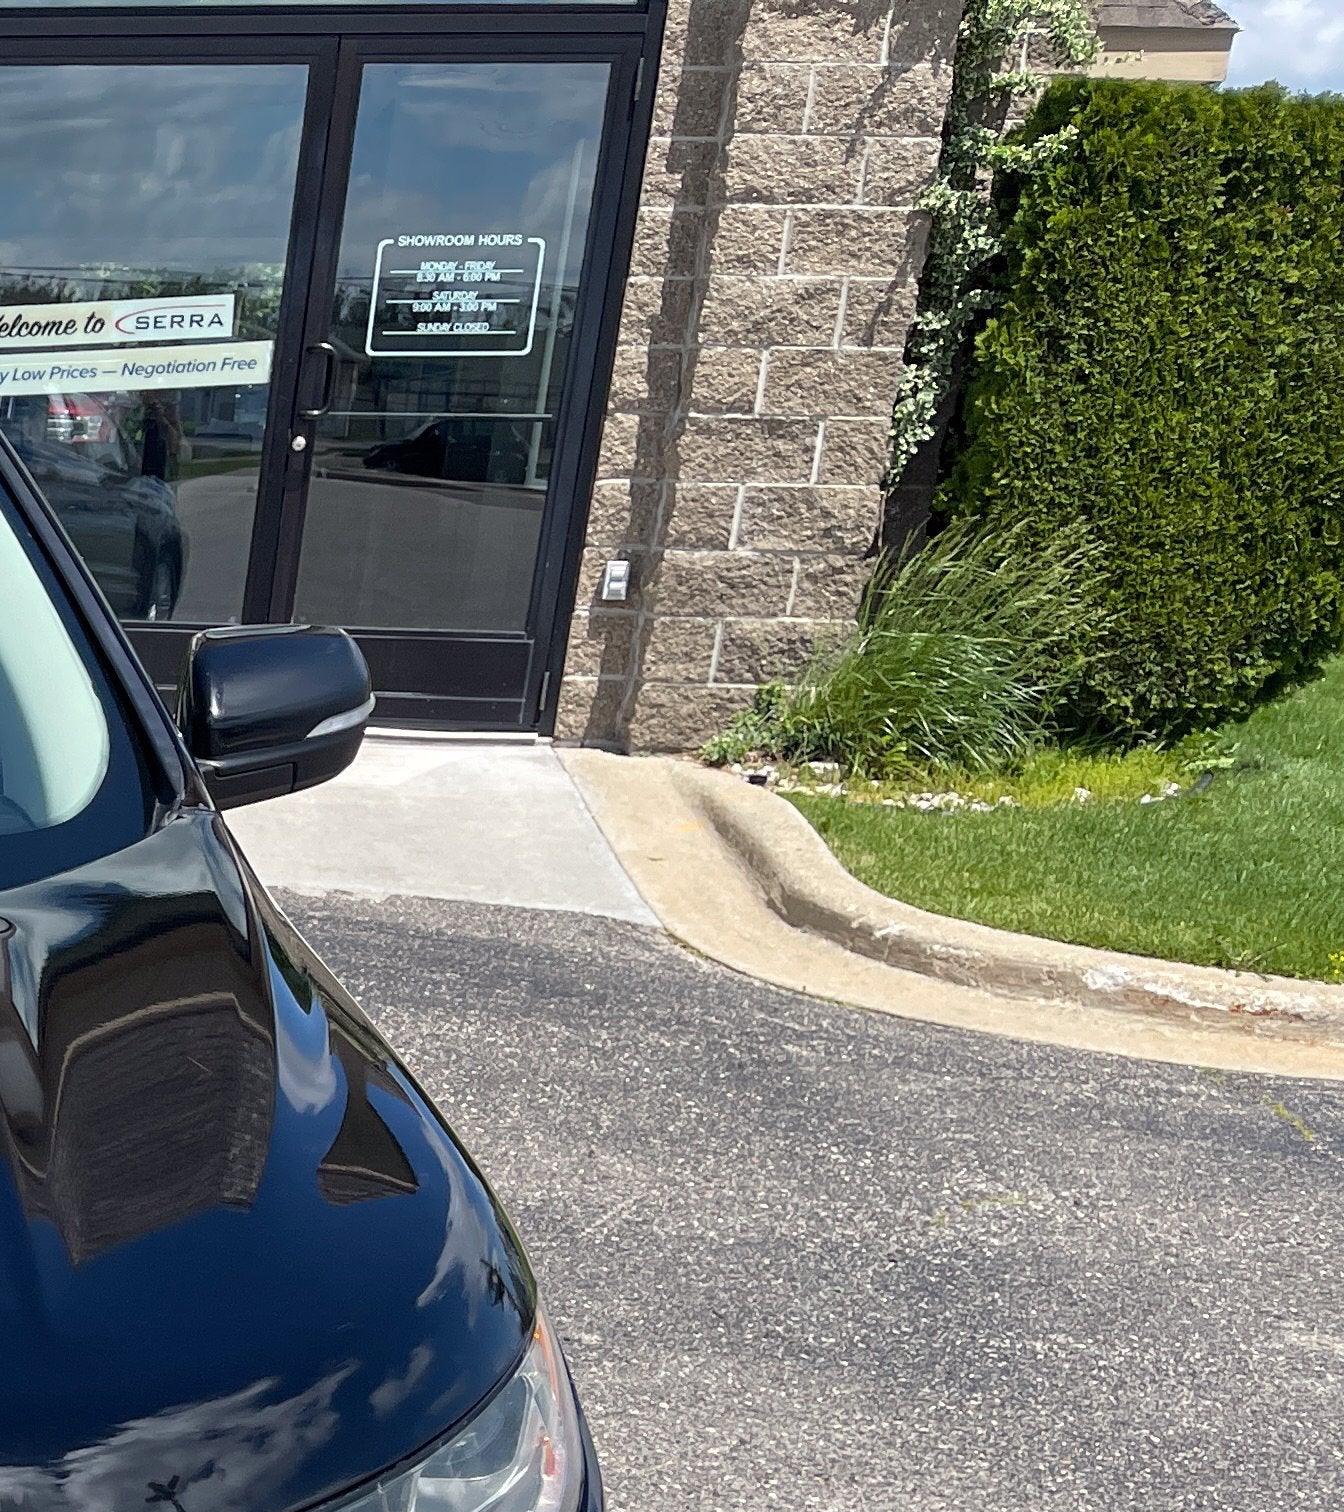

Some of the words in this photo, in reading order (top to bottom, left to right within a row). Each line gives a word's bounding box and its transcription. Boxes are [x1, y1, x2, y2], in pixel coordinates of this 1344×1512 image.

[398, 235, 474, 247] SHOWROOM
[478, 234, 523, 246] HOURS
[420, 261, 458, 271] MONDAY
[464, 261, 496, 271] FRIDAY
[437, 271, 455, 282] AM
[485, 271, 501, 282] PM
[432, 291, 478, 301] SATURDAY
[434, 301, 451, 312] AM
[481, 301, 497, 312] PM
[84, 311, 106, 334] to
[135, 313, 224, 330] SERRA
[416, 322, 452, 332] SUNDAY
[453, 322, 490, 332] CLOSED
[12, 368, 46, 381] Low
[49, 365, 98, 379] Prices
[121, 359, 217, 379] Negotiation
[221, 357, 258, 371] Free
